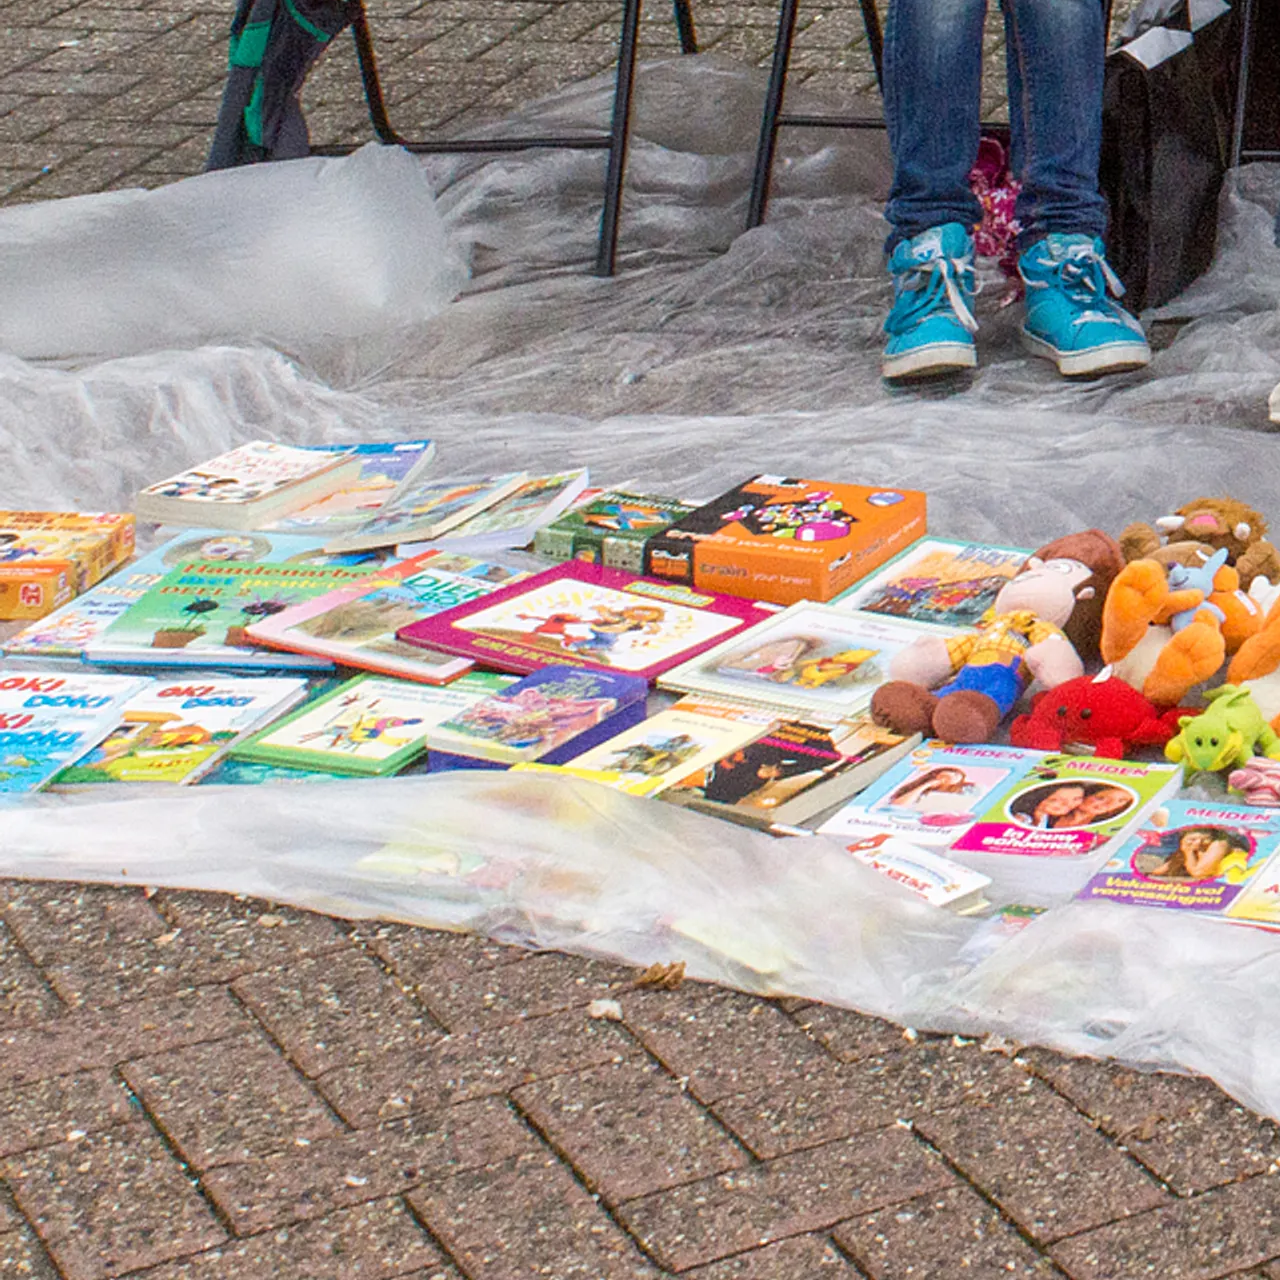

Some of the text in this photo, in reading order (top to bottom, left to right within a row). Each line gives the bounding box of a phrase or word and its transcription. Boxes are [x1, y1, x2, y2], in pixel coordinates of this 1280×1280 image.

[0, 677, 66, 693] OKI
[157, 685, 217, 698] OKI
[23, 694, 114, 708] DOKI
[181, 696, 256, 709] DOKI
[0, 714, 35, 730] KI
[942, 746, 1026, 762] MEIDEN
[1065, 759, 1150, 777] MEIDEN
[1186, 807, 1272, 822] MEIDEN
[1106, 877, 1226, 896] Vakantie vol
[1092, 887, 1222, 906] verrassingen
